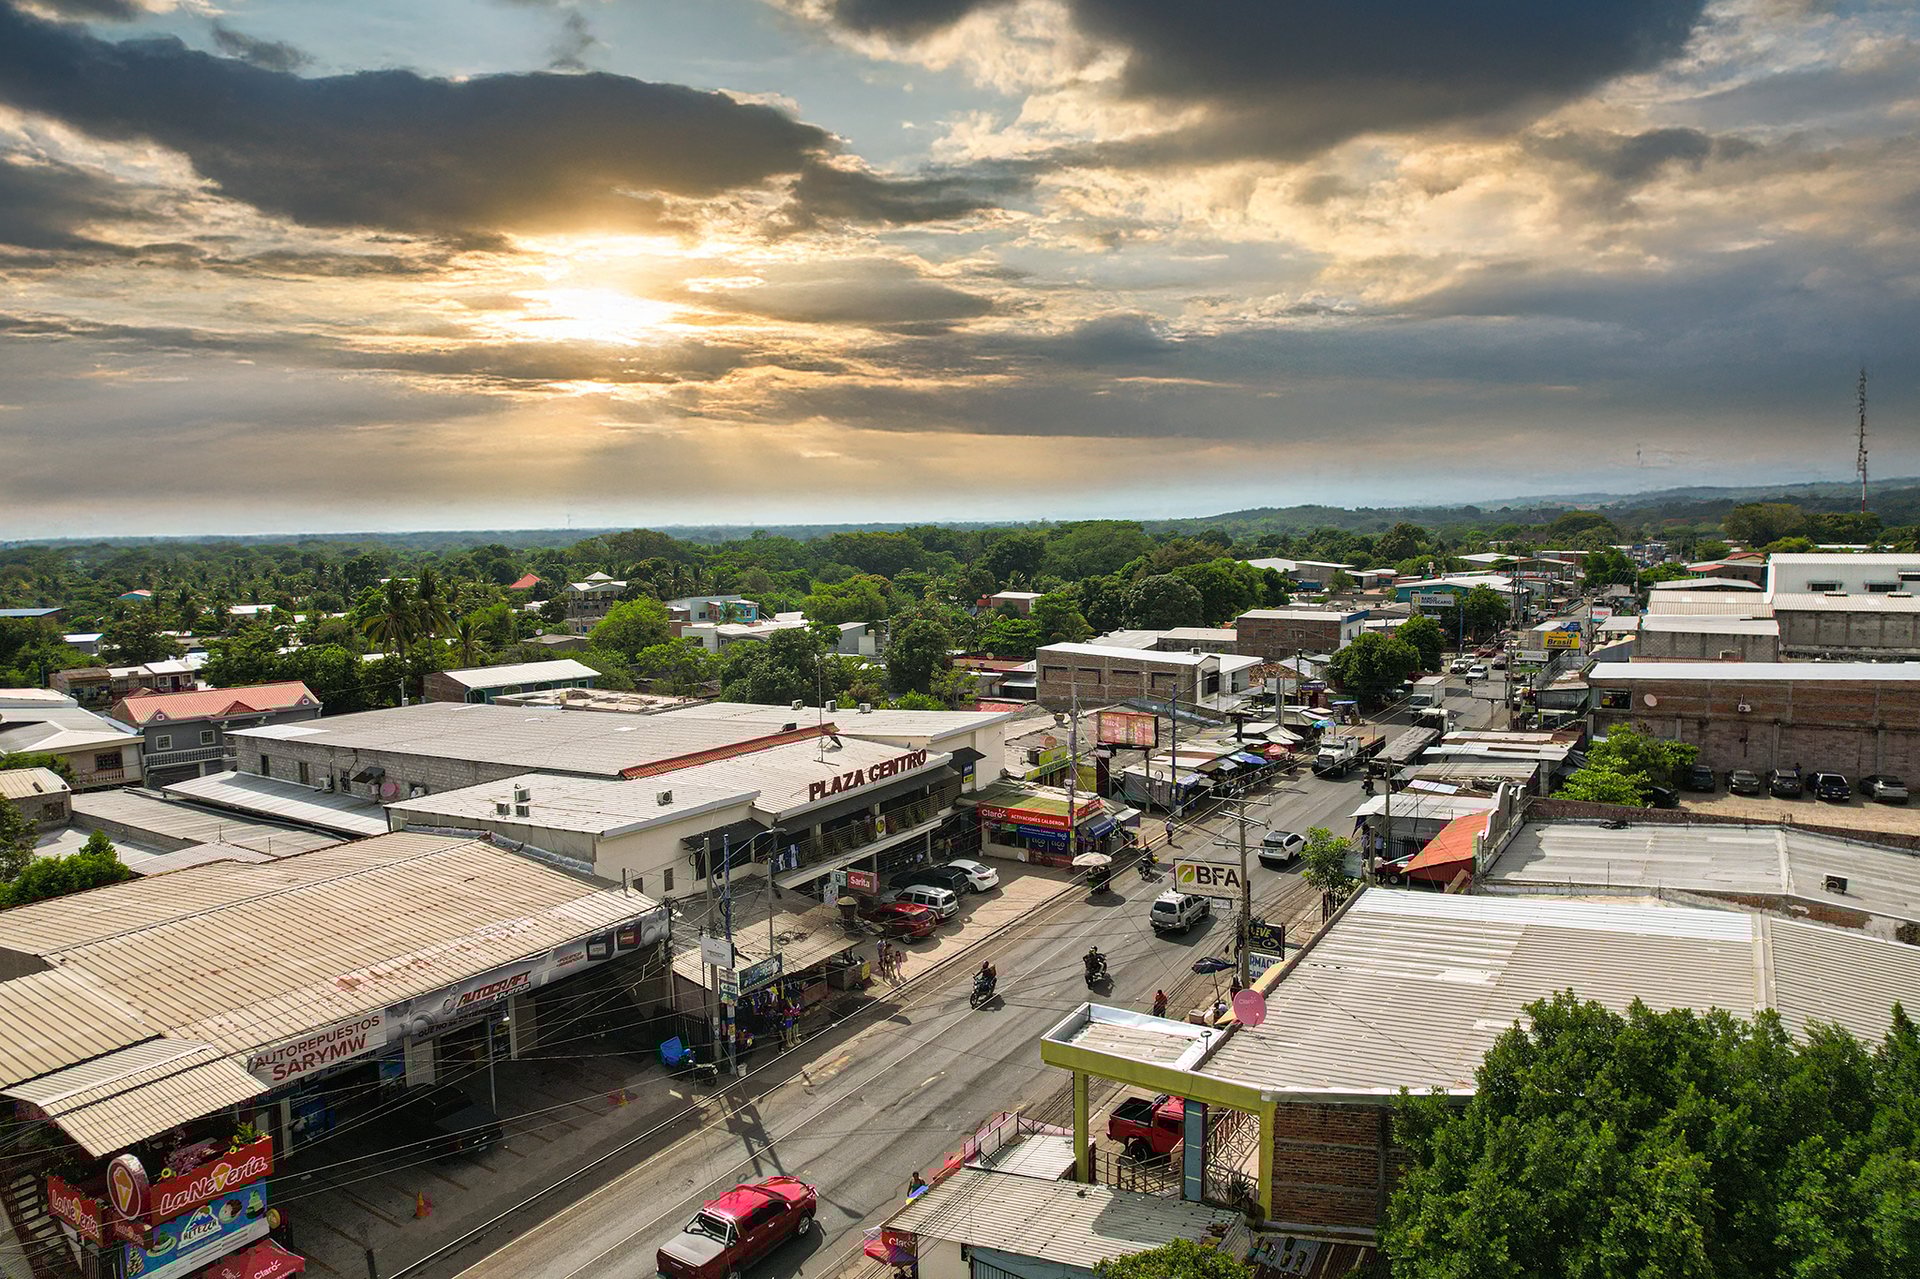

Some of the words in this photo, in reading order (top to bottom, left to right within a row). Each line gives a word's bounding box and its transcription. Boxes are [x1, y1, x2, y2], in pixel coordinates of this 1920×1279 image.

[809, 769, 865, 802] PLAZA
[868, 749, 927, 782] CENTRO
[981, 808, 1004, 819] Claro
[1011, 814, 1041, 823] ACTIVACIONES
[850, 876, 870, 888] Sarita
[1196, 866, 1241, 888] BFA
[455, 971, 531, 1008] AUTOCRAFT
[255, 1015, 380, 1070] AUTOREPUESTOS
[272, 1033, 367, 1081] SARYMW
[888, 1237, 913, 1248] Claro
[254, 1262, 279, 1279] Claro
